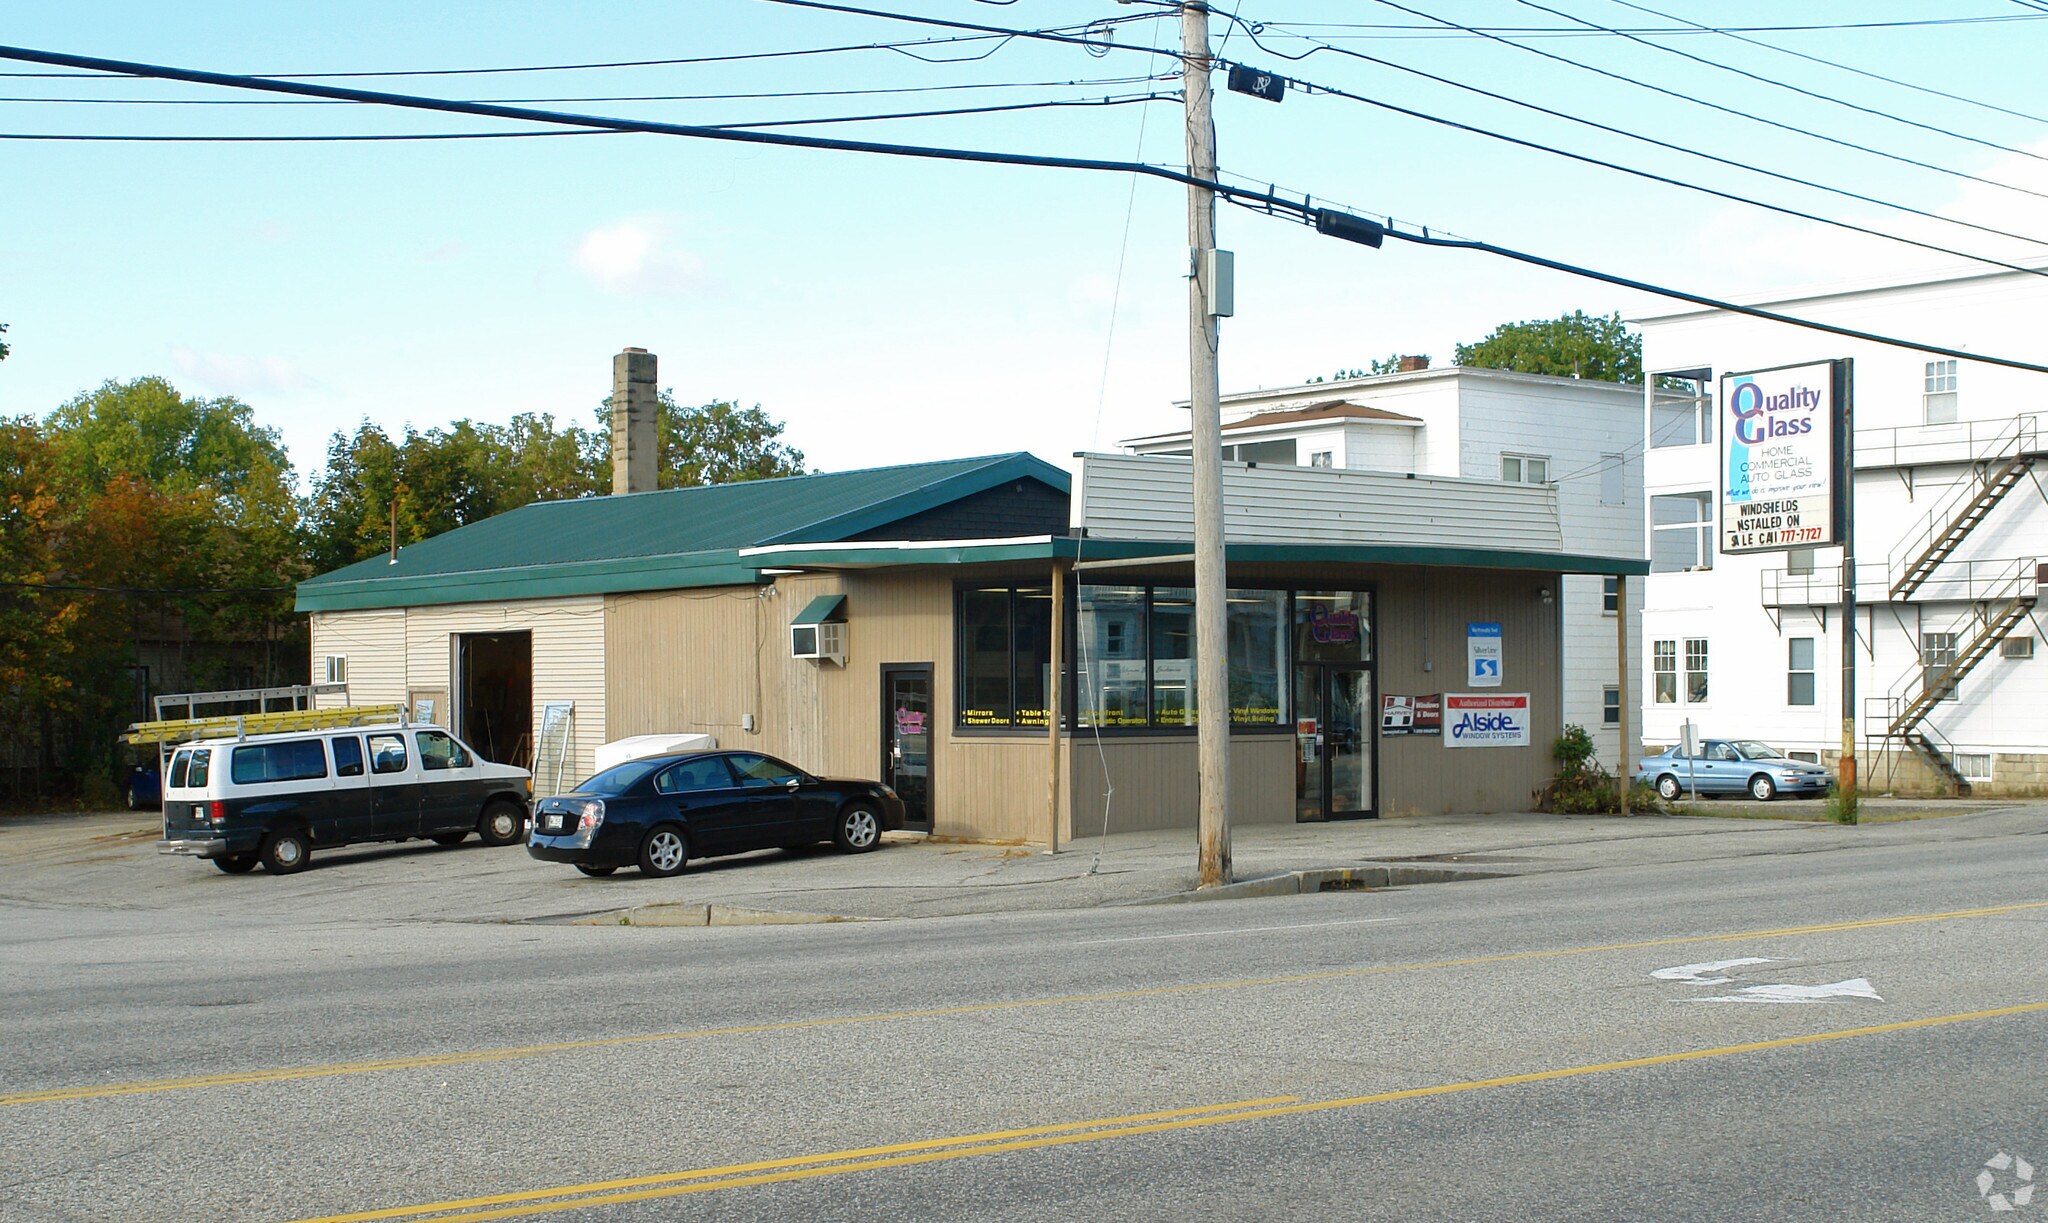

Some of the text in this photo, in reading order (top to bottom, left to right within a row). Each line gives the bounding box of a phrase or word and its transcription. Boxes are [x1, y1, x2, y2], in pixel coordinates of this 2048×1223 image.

[1731, 382, 1820, 419] Quality
[1736, 410, 1812, 444] Glass
[1762, 446, 1793, 456] HOME
[1740, 458, 1812, 473] COMMERCIAL
[1741, 468, 1812, 484] AUTO GLASS
[1793, 484, 1806, 492] your
[1787, 514, 1800, 527] ON
[1781, 528, 1822, 542] 777-7727
[1233, 708, 1248, 716] Vinyl
[1233, 716, 1250, 724] Vinyl
[1453, 712, 1520, 738] Alside
